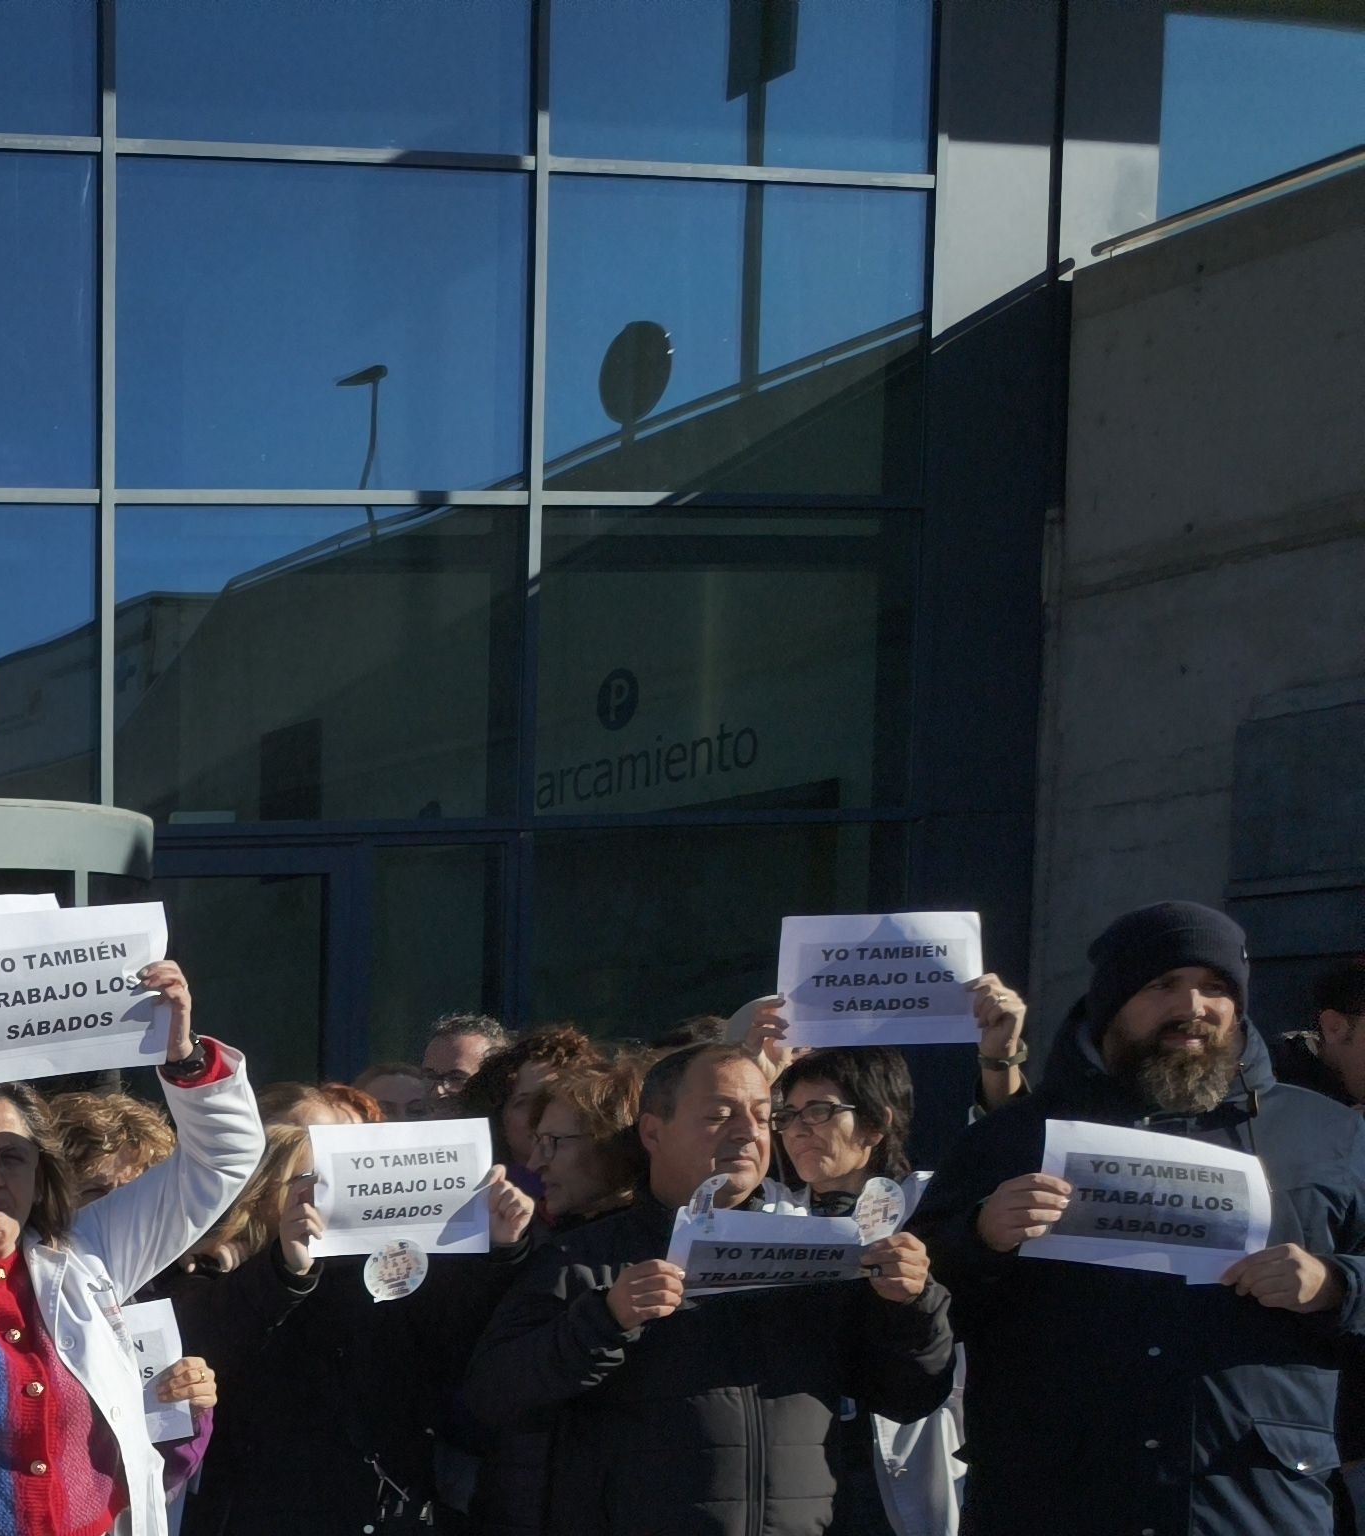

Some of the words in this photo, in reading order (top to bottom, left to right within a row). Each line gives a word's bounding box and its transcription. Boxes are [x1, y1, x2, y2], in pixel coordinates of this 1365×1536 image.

[22, 942, 127, 971] TAMBIÉN
[821, 946, 852, 962] YO
[856, 940, 949, 961] TAMBIÉN
[95, 973, 139, 996] LOS
[811, 970, 910, 989] TRABAJO
[914, 968, 956, 984] LOS
[832, 992, 930, 1013] SÁBADOS
[6, 1009, 115, 1040] SÁBADOS
[350, 1155, 376, 1168] YO
[380, 1148, 459, 1167] TAMBIÉN
[1089, 1158, 1121, 1177] YO
[1125, 1158, 1226, 1185] TAMBIÉN
[346, 1178, 429, 1198] TRABAJO
[432, 1176, 467, 1191] LOS
[361, 1200, 444, 1221] SÁBADOS
[1077, 1187, 1177, 1210] TRABAJO
[1190, 1194, 1235, 1212] LOS
[1095, 1212, 1207, 1240] SÁBADOS
[714, 1247, 743, 1260] YO
